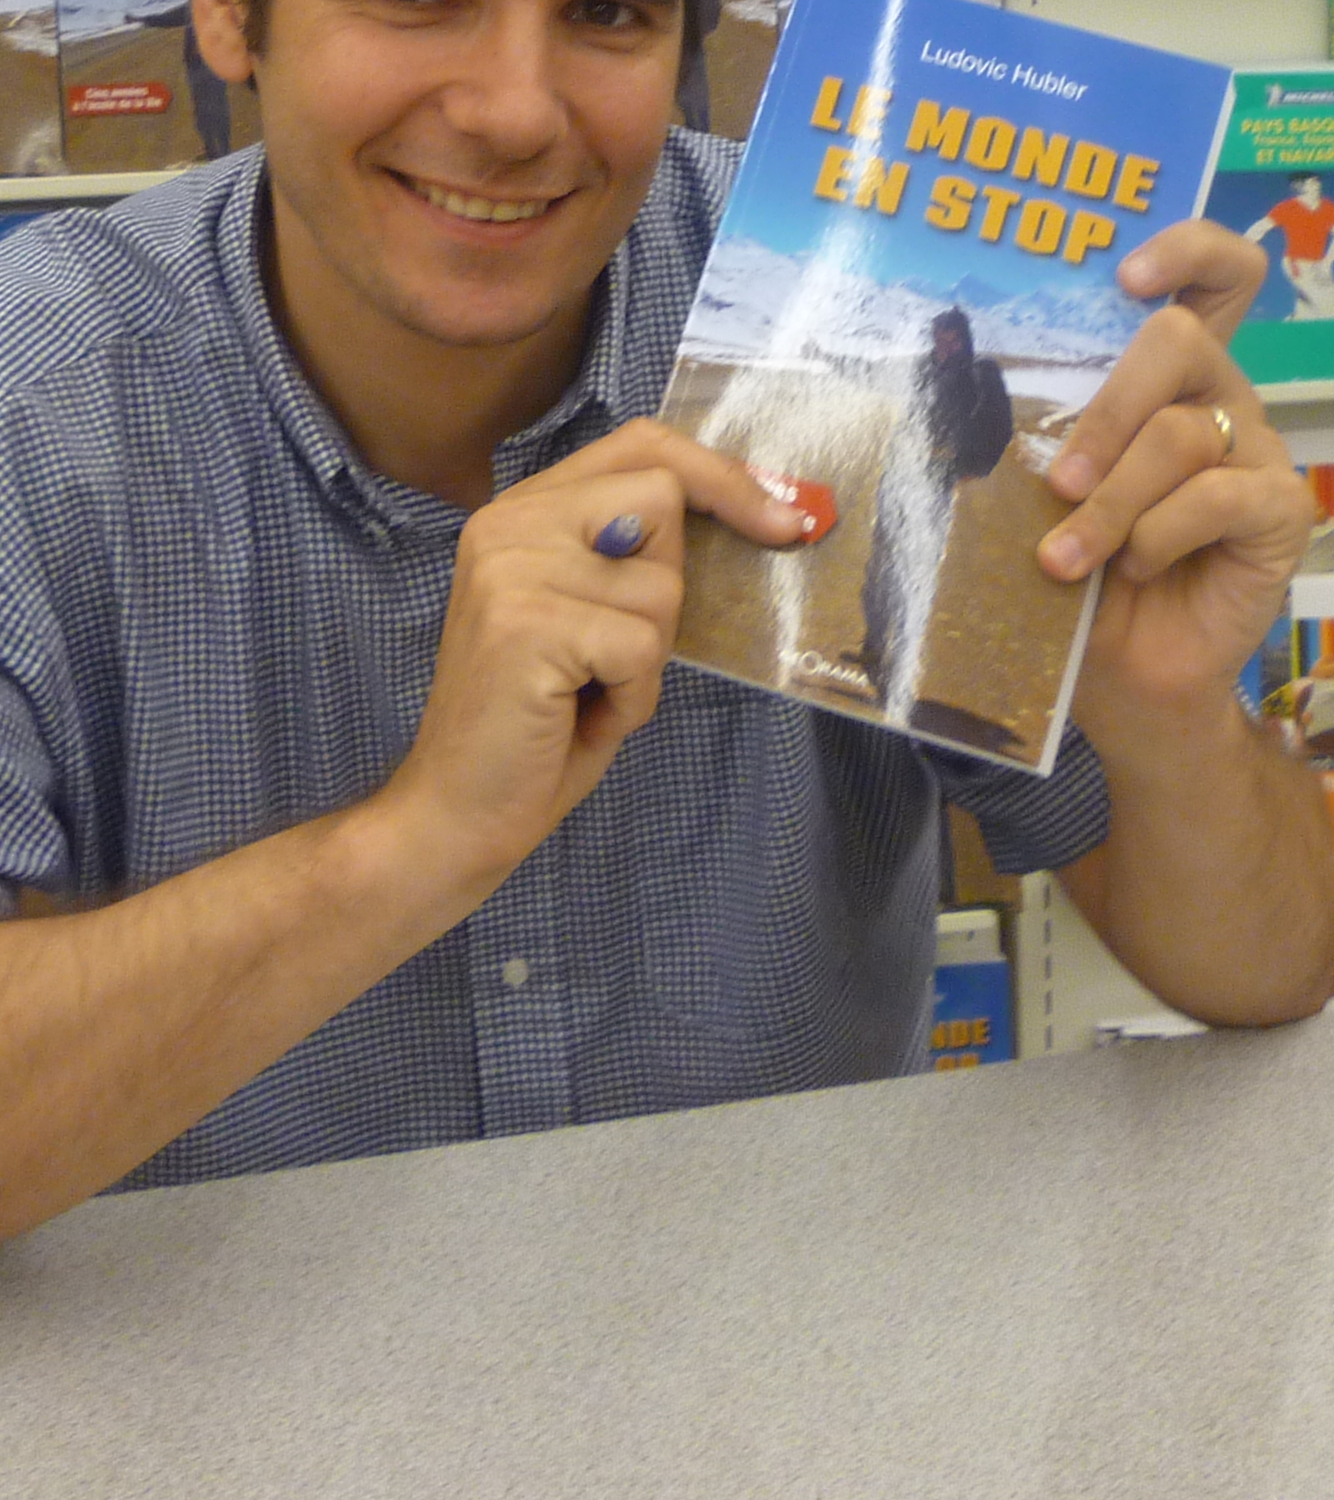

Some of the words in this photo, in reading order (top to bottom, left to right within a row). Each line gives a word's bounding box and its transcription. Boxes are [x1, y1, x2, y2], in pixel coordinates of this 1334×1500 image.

[919, 40, 1008, 83] Ludovic
[1011, 64, 1089, 103] Hubler
[810, 76, 892, 139] LE
[905, 99, 1162, 214] MONDE
[1241, 118, 1283, 135] PAYS
[814, 145, 911, 217] EN
[924, 174, 1118, 265] STOP
